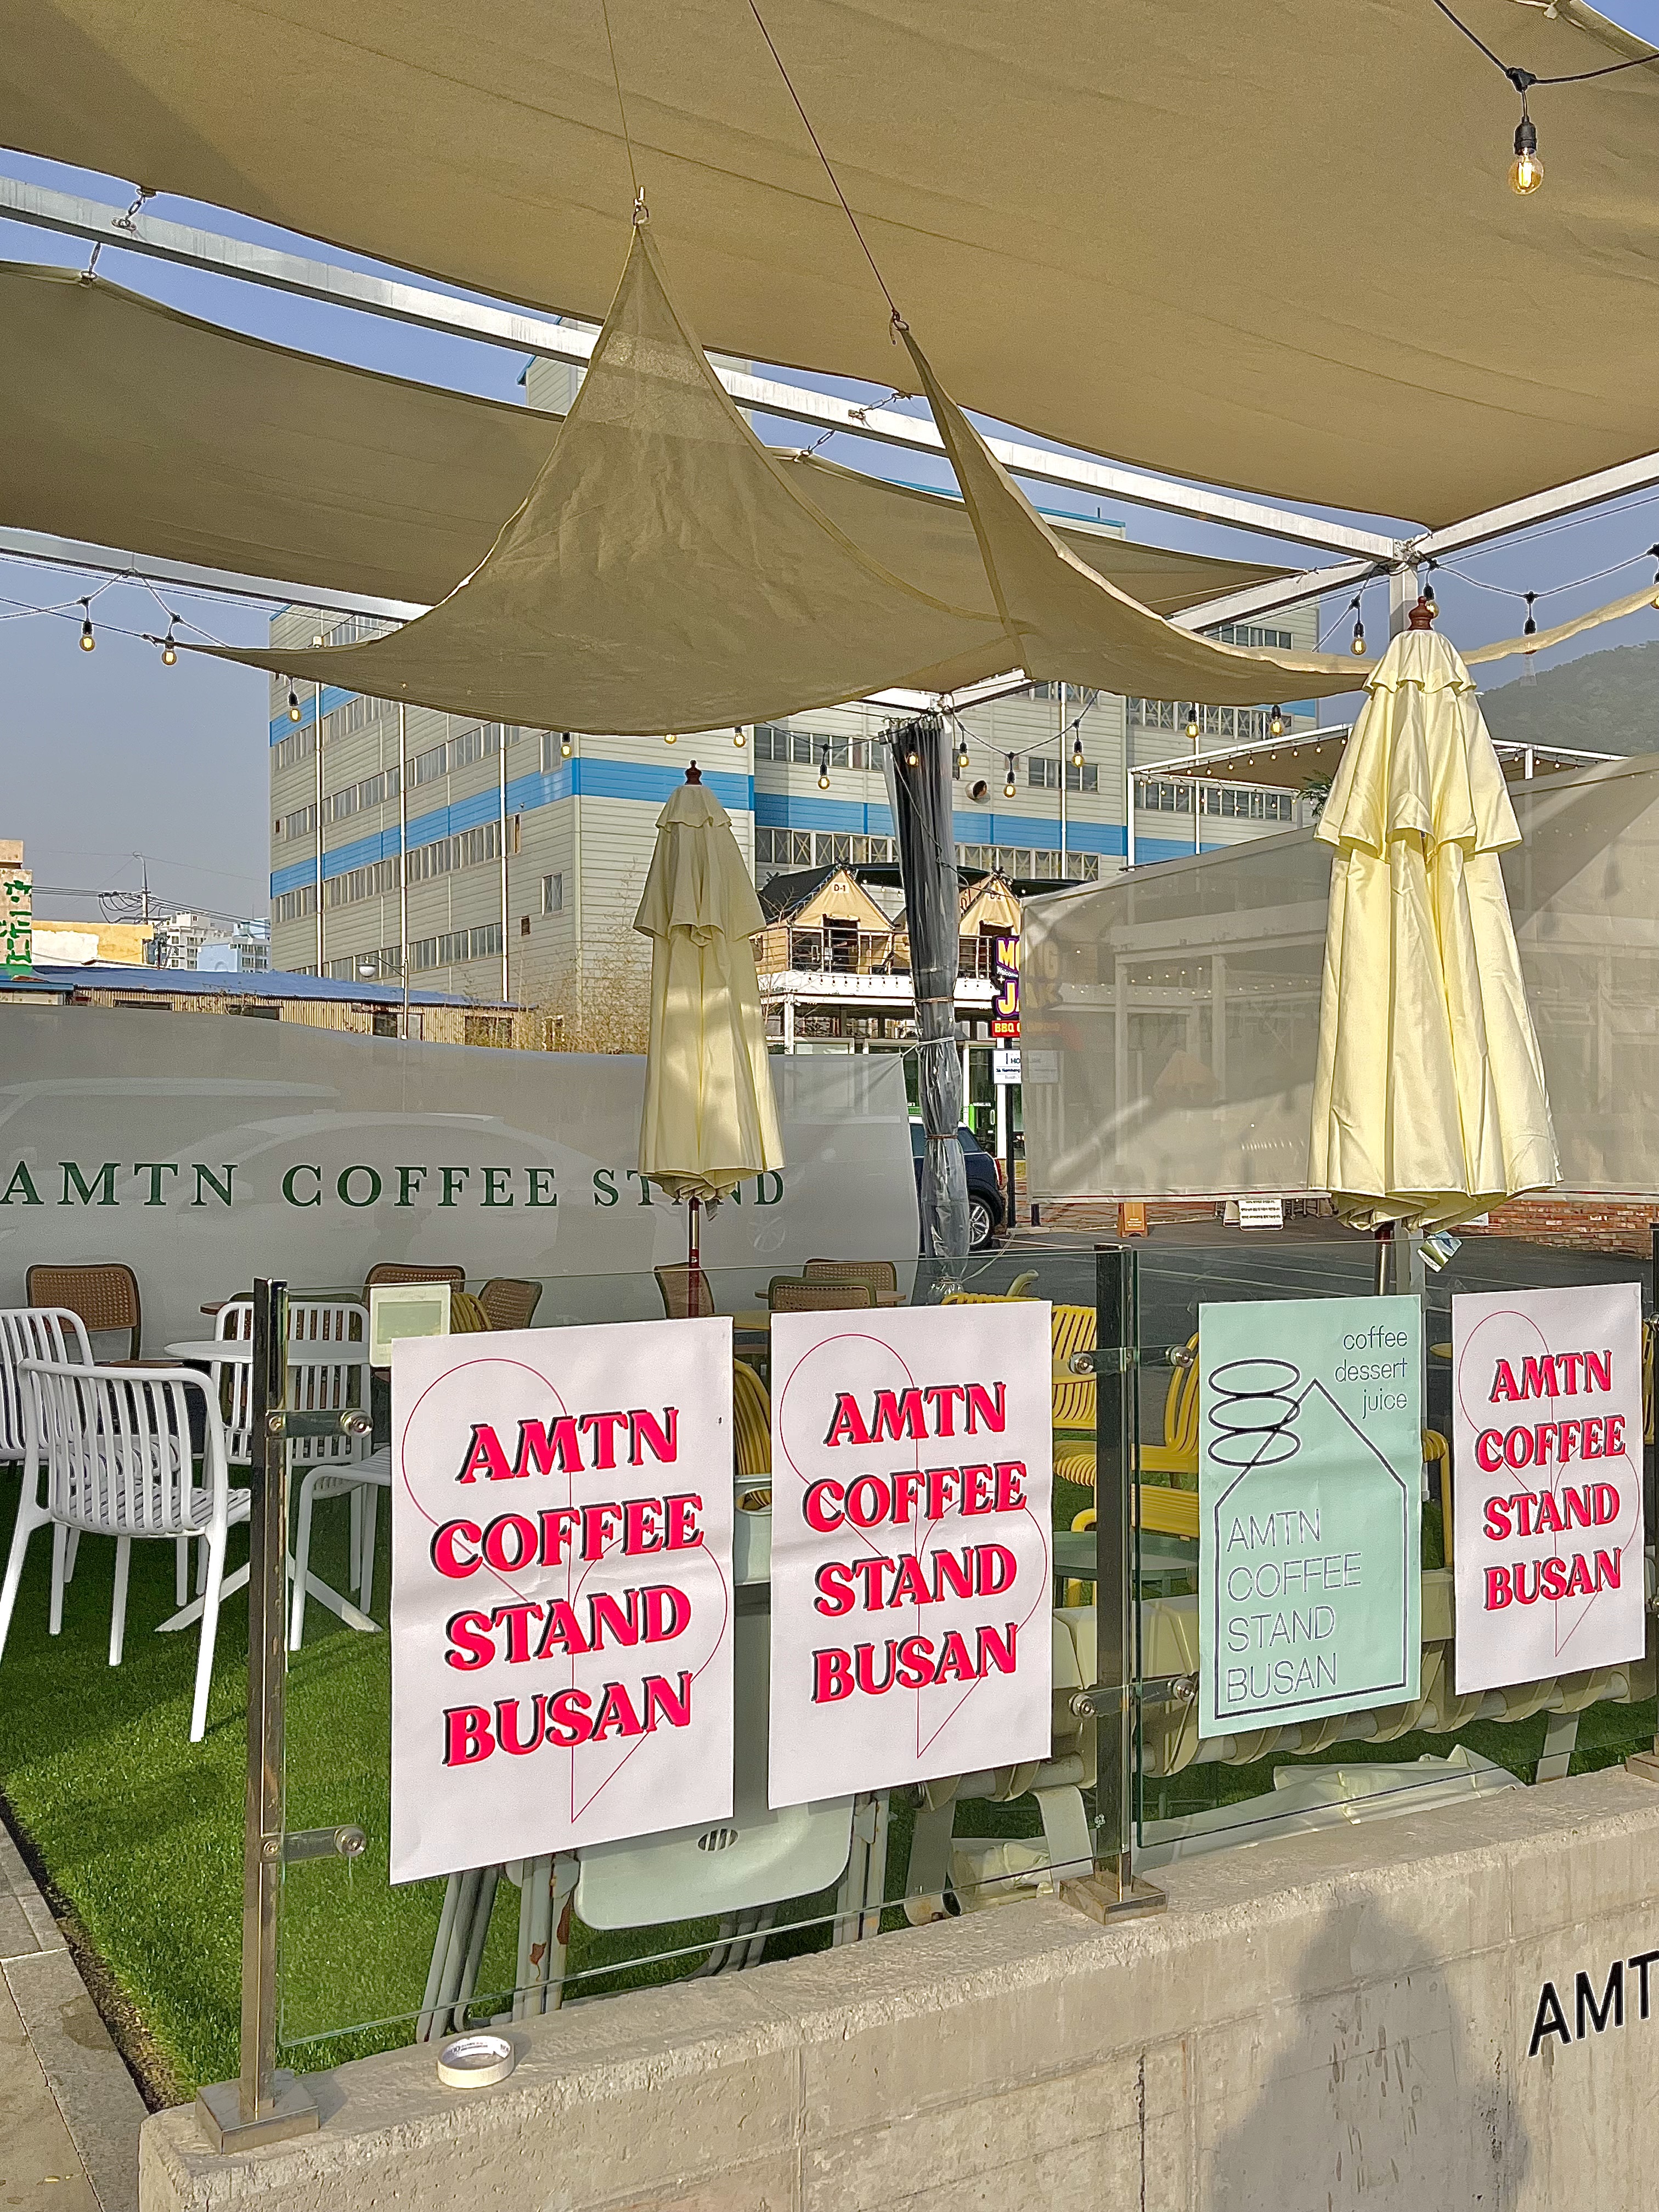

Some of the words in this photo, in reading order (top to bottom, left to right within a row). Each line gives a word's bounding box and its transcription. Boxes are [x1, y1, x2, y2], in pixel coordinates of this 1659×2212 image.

[994, 1022, 1015, 1033] BBQ
[0, 1160, 238, 1207] AMTN
[281, 1164, 557, 1207] COFFEE
[592, 1169, 783, 1207] STD
[1344, 1325, 1408, 1350] coffee
[1335, 1358, 1408, 1383] dessert
[1488, 1349, 1612, 1403] AMTN
[823, 1381, 1007, 1447] AMTN
[1362, 1388, 1408, 1420] juice
[455, 1407, 679, 1484] AMTN
[1474, 1414, 1626, 1472] COFFEE
[802, 1461, 1027, 1532] COFFEE
[1483, 1482, 1620, 1541] STAND
[430, 1493, 704, 1578] COFFEE
[1227, 1508, 1320, 1552] AMTN
[814, 1543, 1017, 1617] STAND
[1228, 1553, 1361, 1601] COFFEE
[1483, 1547, 1622, 1611] BUSAN
[444, 1585, 692, 1671] STAND
[1227, 1606, 1335, 1652] STAND
[811, 1622, 1018, 1703] BUSAN
[1227, 1652, 1336, 1703] BUSAN
[442, 1671, 693, 1767] BUSAN
[1528, 1950, 1659, 2057] AMT
